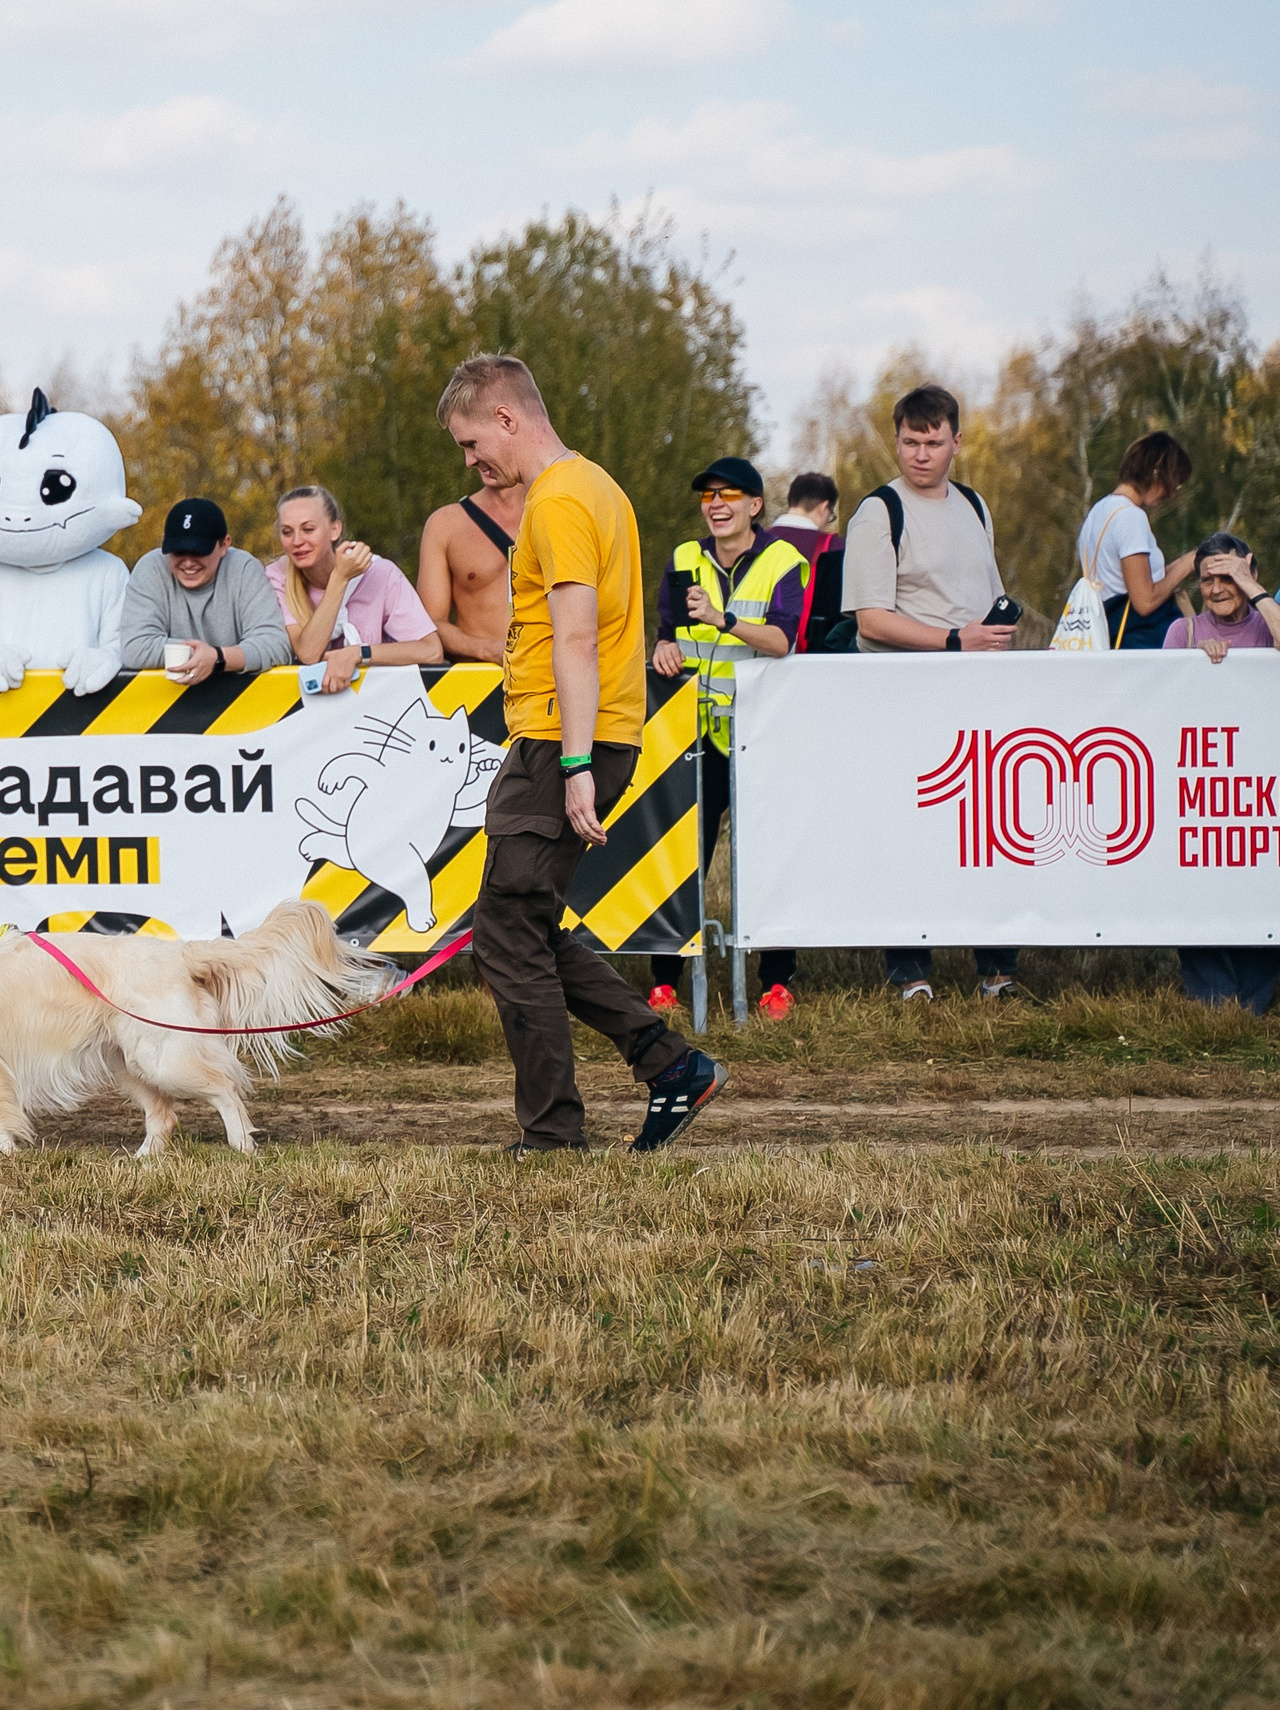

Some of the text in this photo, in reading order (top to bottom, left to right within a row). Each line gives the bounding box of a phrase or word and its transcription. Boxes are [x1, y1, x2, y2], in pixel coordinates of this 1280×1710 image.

[1177, 726, 1239, 768] ЛЕТ
[917, 726, 1154, 867] 100
[1179, 776, 1277, 817] МОСК
